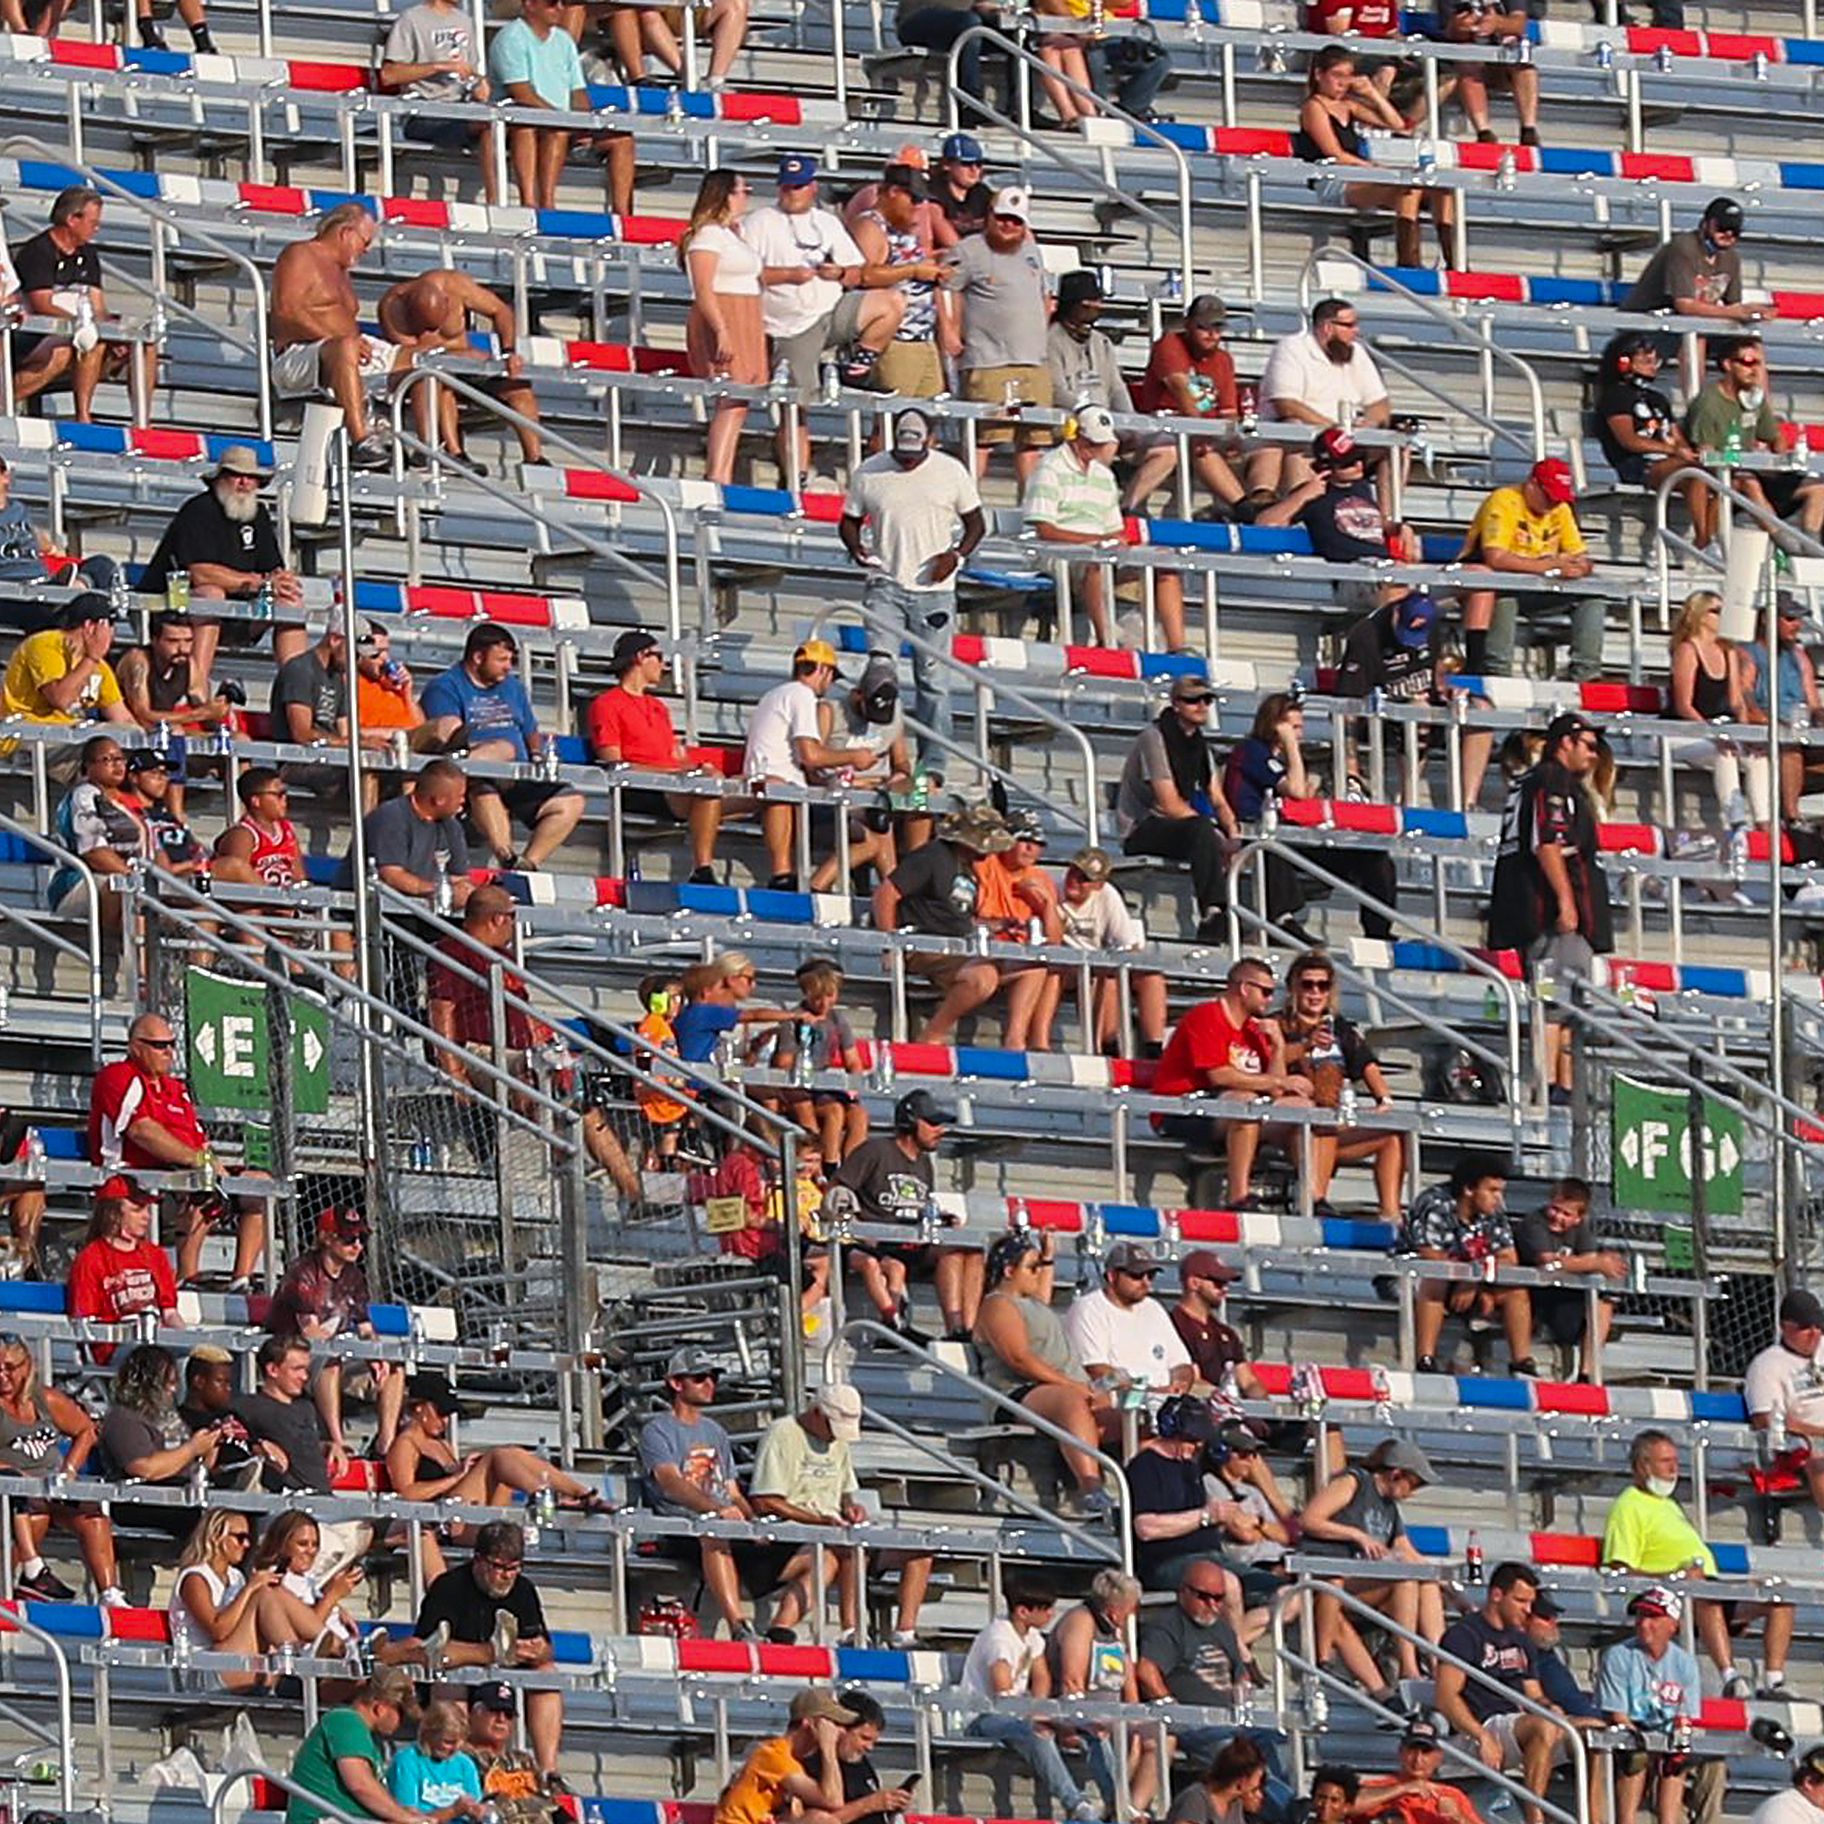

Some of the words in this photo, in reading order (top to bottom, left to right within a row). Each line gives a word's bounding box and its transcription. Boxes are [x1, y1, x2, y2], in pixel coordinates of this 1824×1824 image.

[222, 1016, 255, 1078] E
[1641, 1120, 1670, 1180] F
[1679, 1124, 1717, 1182] G
